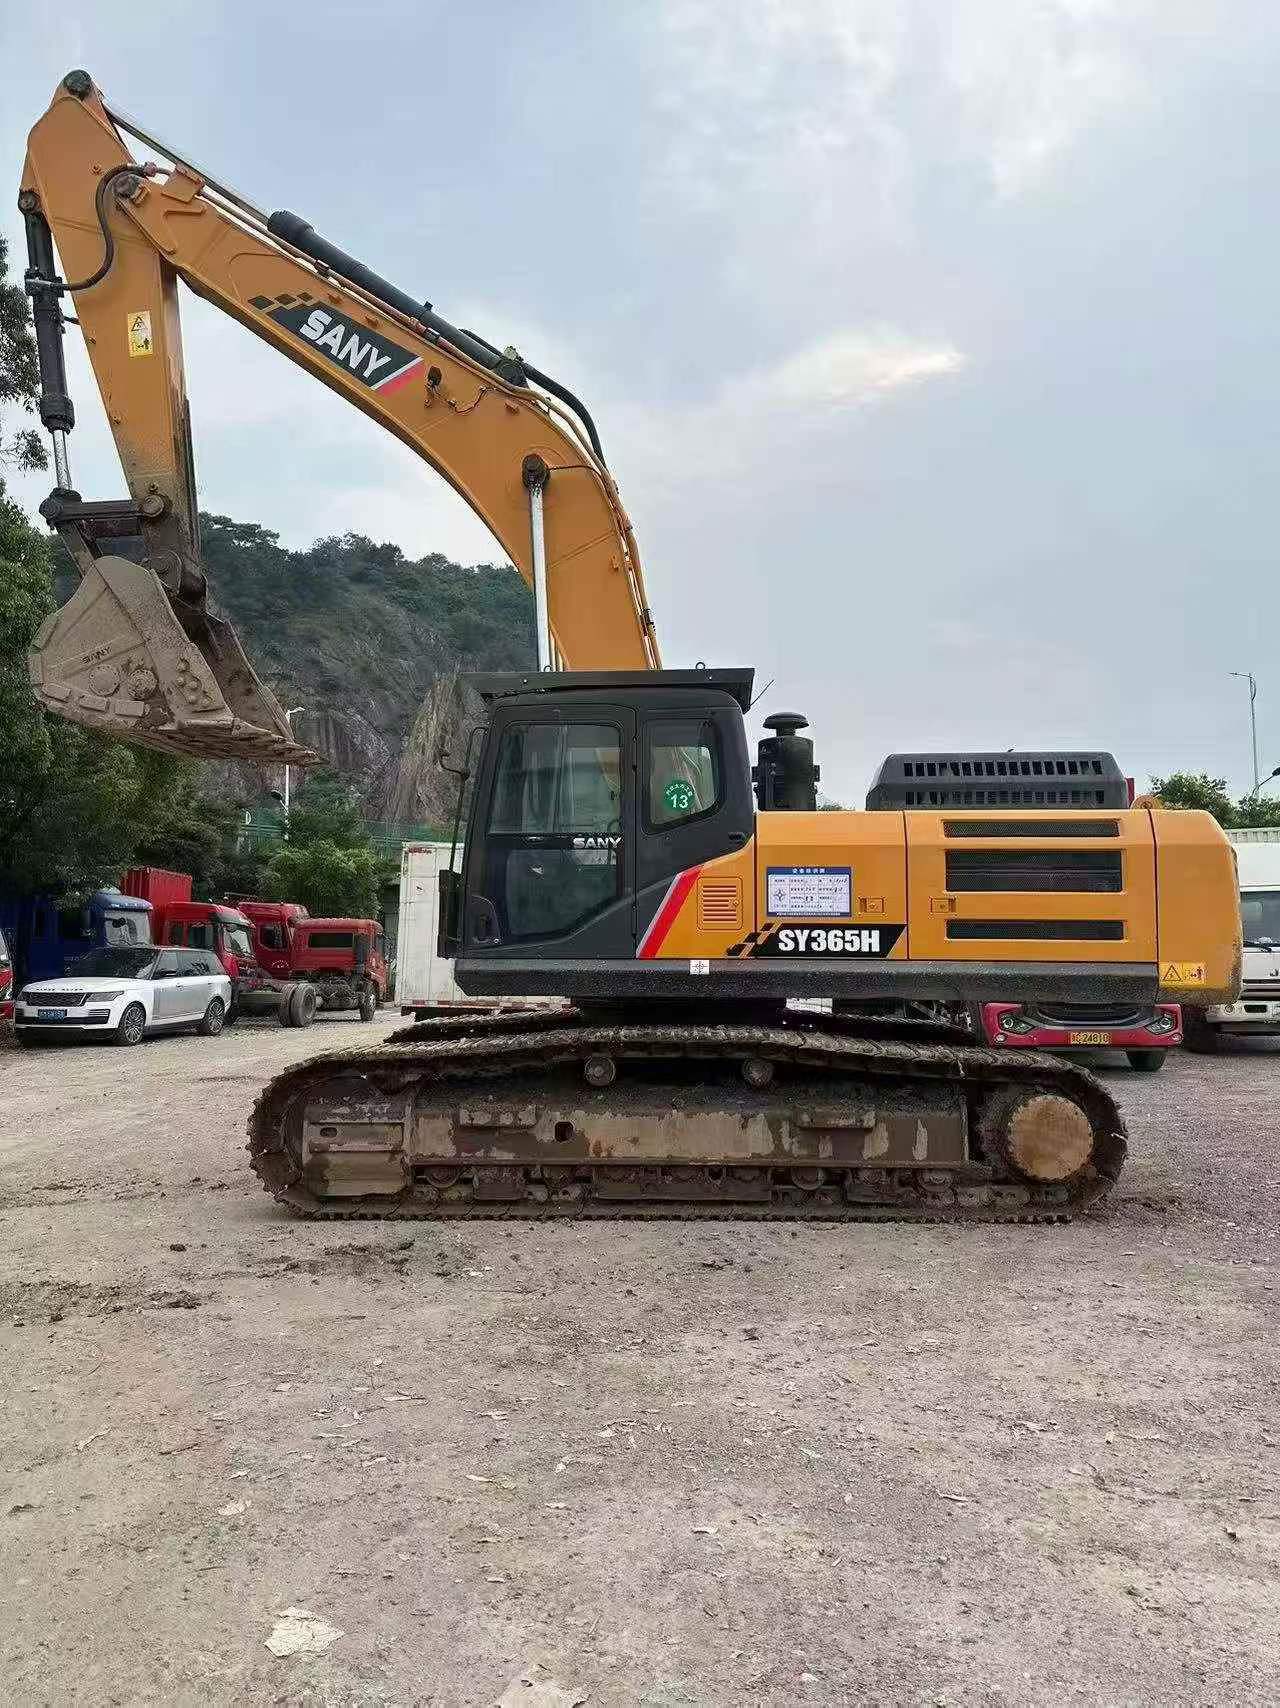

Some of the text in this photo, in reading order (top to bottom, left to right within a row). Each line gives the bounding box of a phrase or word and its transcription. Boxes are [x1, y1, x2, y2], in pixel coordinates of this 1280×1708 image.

[299, 309, 392, 378] SANY
[671, 794, 689, 809] 13
[573, 837, 621, 849] SANY
[778, 929, 881, 953] SY365H
